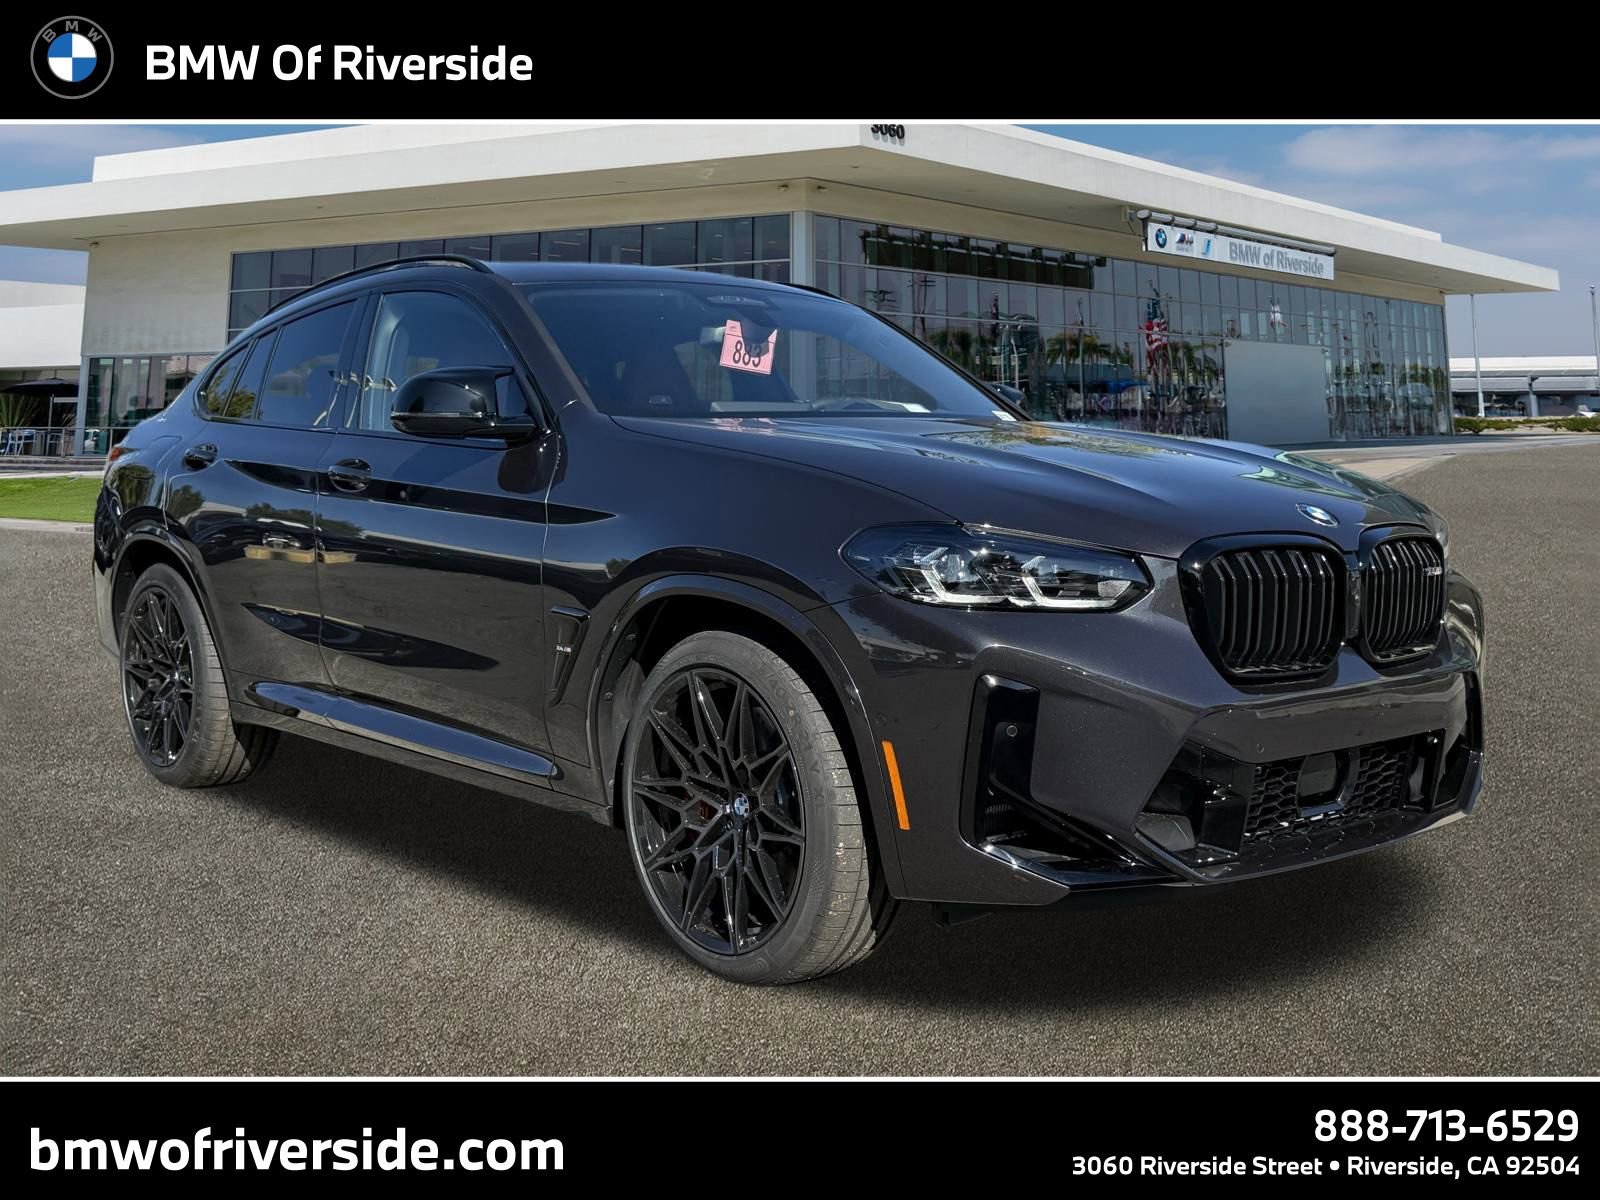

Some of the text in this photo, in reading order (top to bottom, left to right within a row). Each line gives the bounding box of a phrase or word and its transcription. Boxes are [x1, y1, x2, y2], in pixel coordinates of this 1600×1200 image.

[1229, 241, 1324, 275] BMW of Riverside
